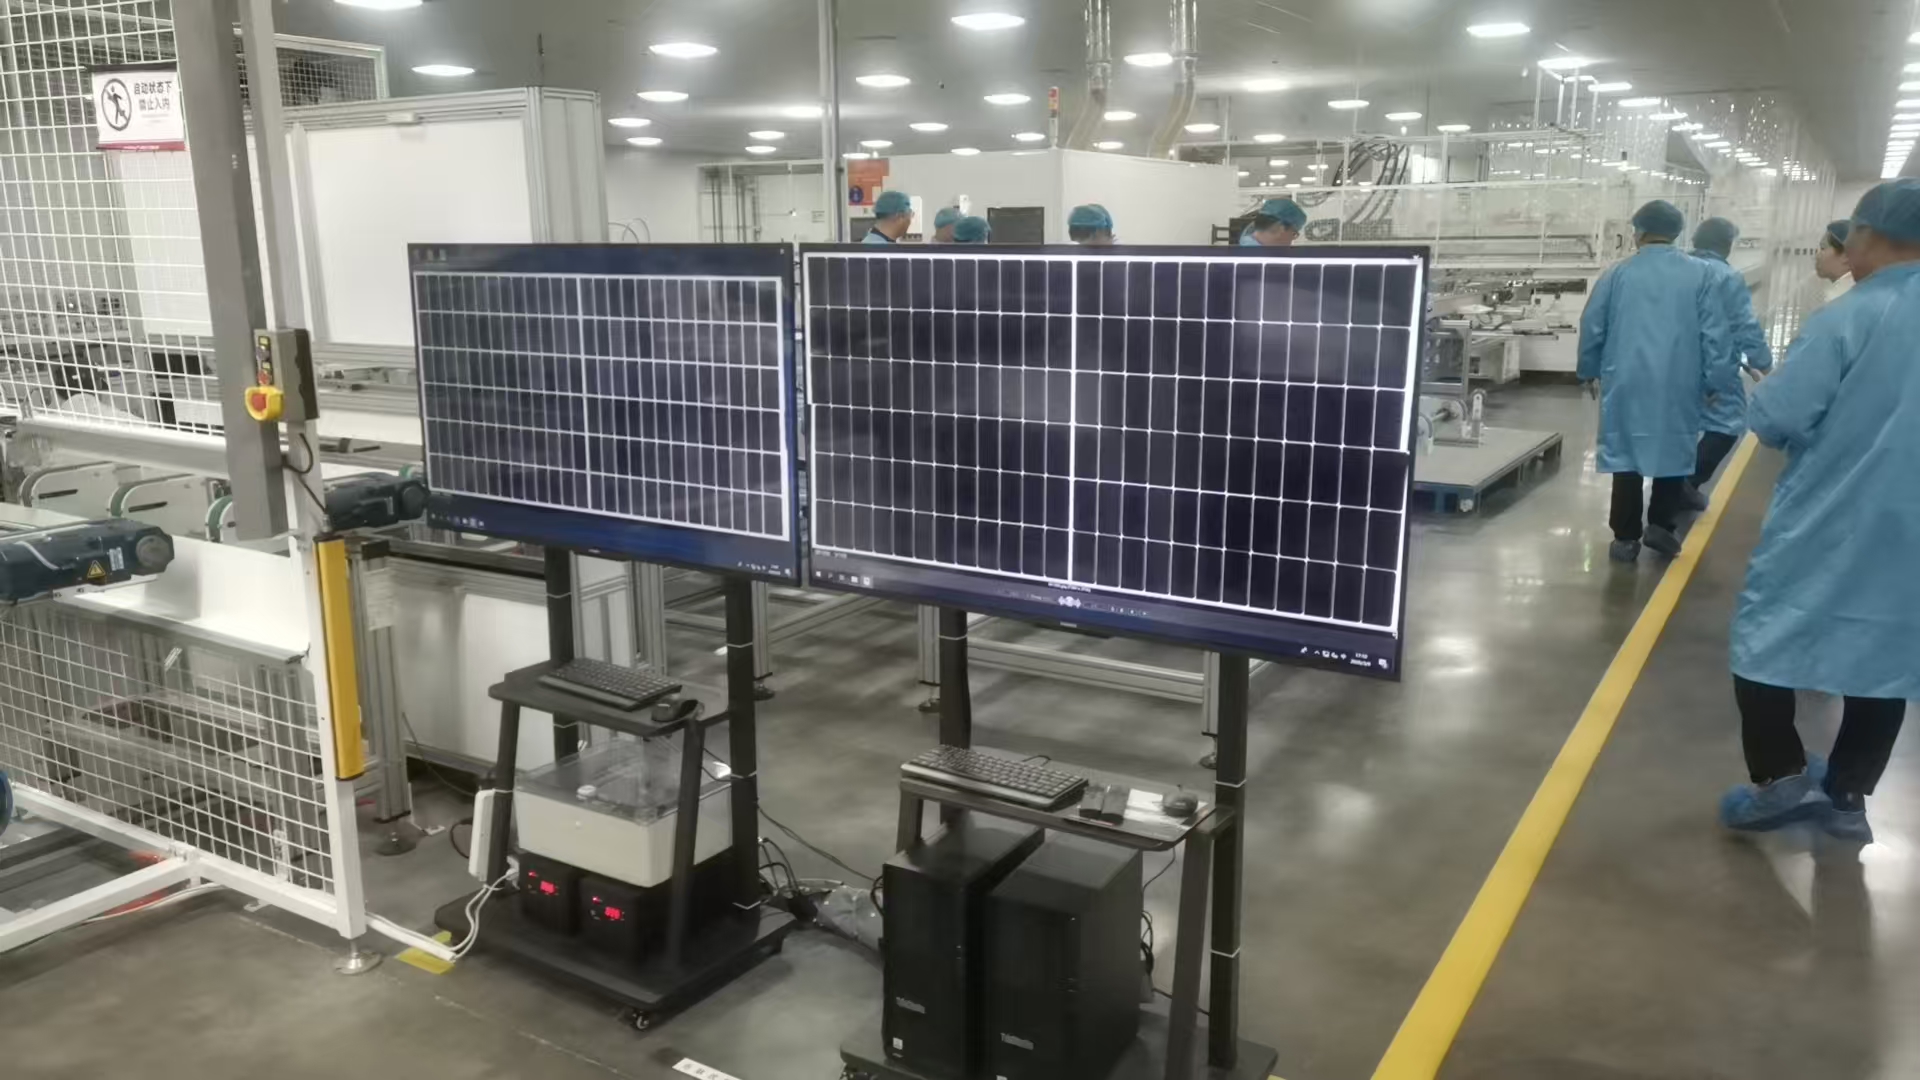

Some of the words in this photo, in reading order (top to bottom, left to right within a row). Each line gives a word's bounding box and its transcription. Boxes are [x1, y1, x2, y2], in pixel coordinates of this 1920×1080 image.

[134, 81, 172, 95] 自动状态下
